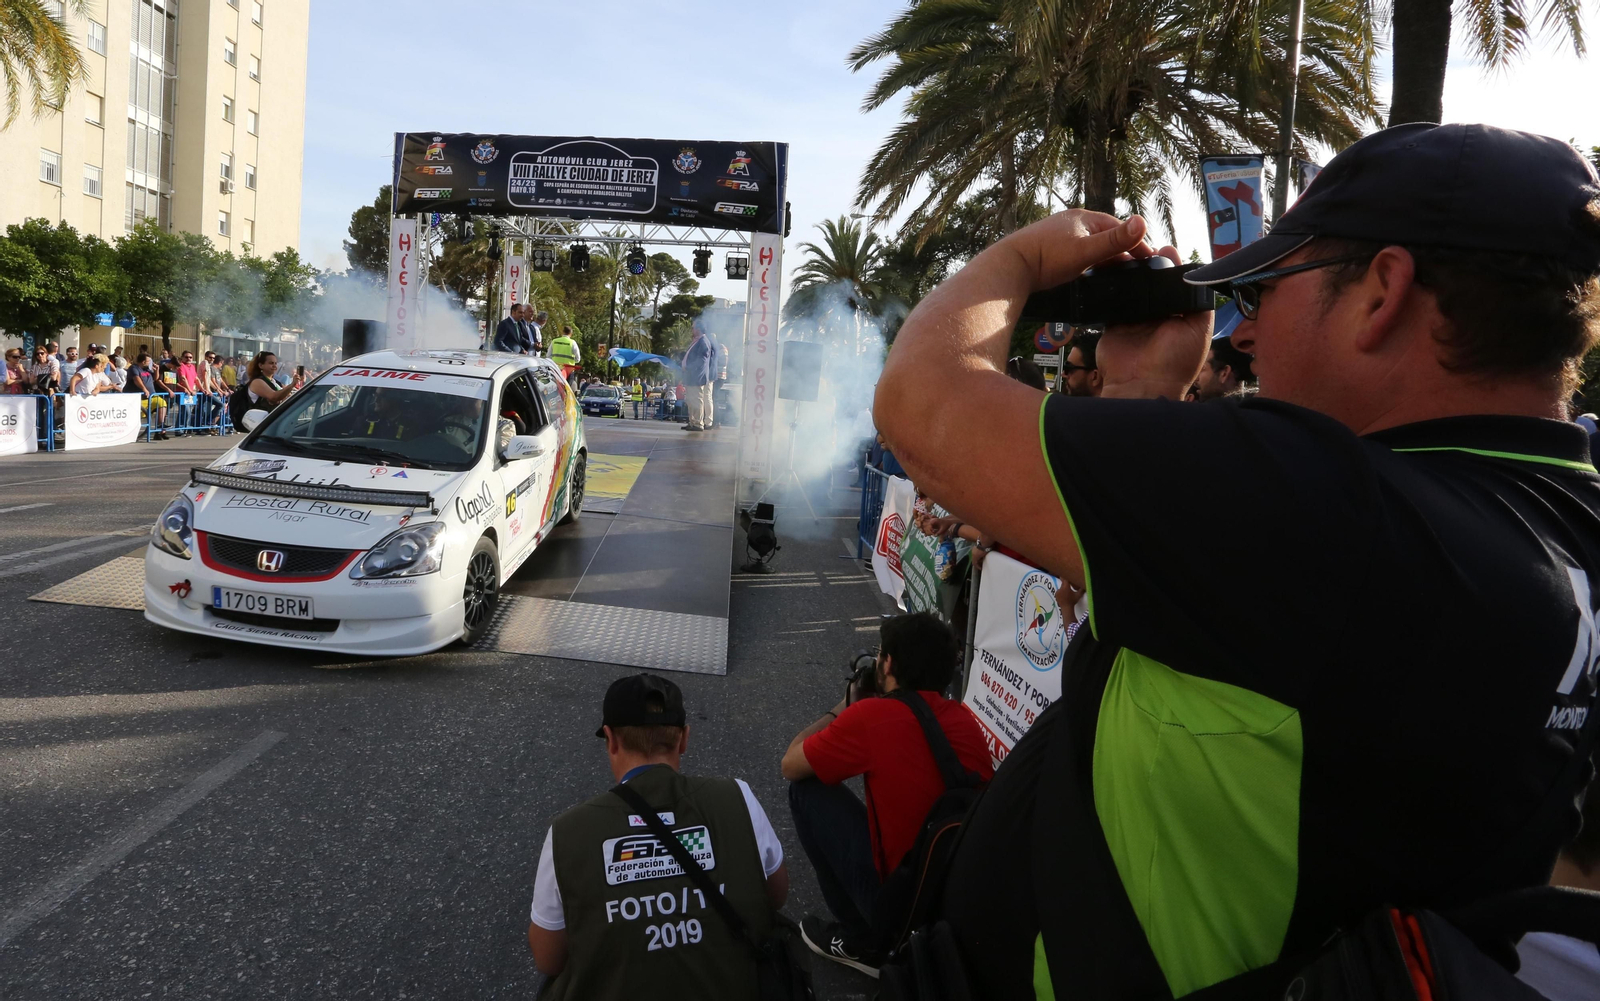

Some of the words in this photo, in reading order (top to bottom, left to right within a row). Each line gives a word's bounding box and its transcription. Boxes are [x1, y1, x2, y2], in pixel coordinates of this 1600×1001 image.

[536, 155, 584, 165] AUTOMÓVIL
[586, 158, 608, 166] CLUB
[610, 160, 633, 168] JEREZ
[512, 164, 532, 178] VIII
[532, 165, 568, 180] RALLYE
[569, 167, 608, 182] CIUDAD
[610, 169, 624, 182] DE
[626, 170, 655, 184] JEREZ
[510, 186, 536, 194] MAYO.19
[333, 370, 432, 382] JAIME
[90, 406, 128, 420] sevitas
[514, 442, 538, 453] Jaime
[226, 494, 300, 510] Hostal
[308, 499, 372, 522] Rural
[506, 492, 516, 516] 16
[268, 512, 308, 523] Algar
[483, 504, 502, 528] abogados
[225, 590, 268, 612] 1709
[275, 597, 309, 617] BRM
[1019, 574, 1038, 618] FERNÁNDEZ
[1040, 574, 1044, 582] Y
[245, 626, 278, 637] SIERRA
[280, 631, 319, 642] RACING
[1018, 632, 1058, 666] CLIMATIZACIÓN
[980, 649, 1024, 690] FERNÁNDEZ
[1024, 682, 1031, 696] Y
[1030, 688, 1054, 711] POR
[980, 671, 991, 688] 686
[990, 680, 1004, 698] 870
[1004, 690, 1018, 710] 420
[1024, 708, 1036, 725] 95
[984, 708, 994, 720] Solar
[996, 719, 1006, 732] Suelo
[1005, 714, 1026, 736] Ventilació
[608, 858, 664, 874] Federación
[616, 872, 628, 882] de
[645, 918, 703, 952] 2019
